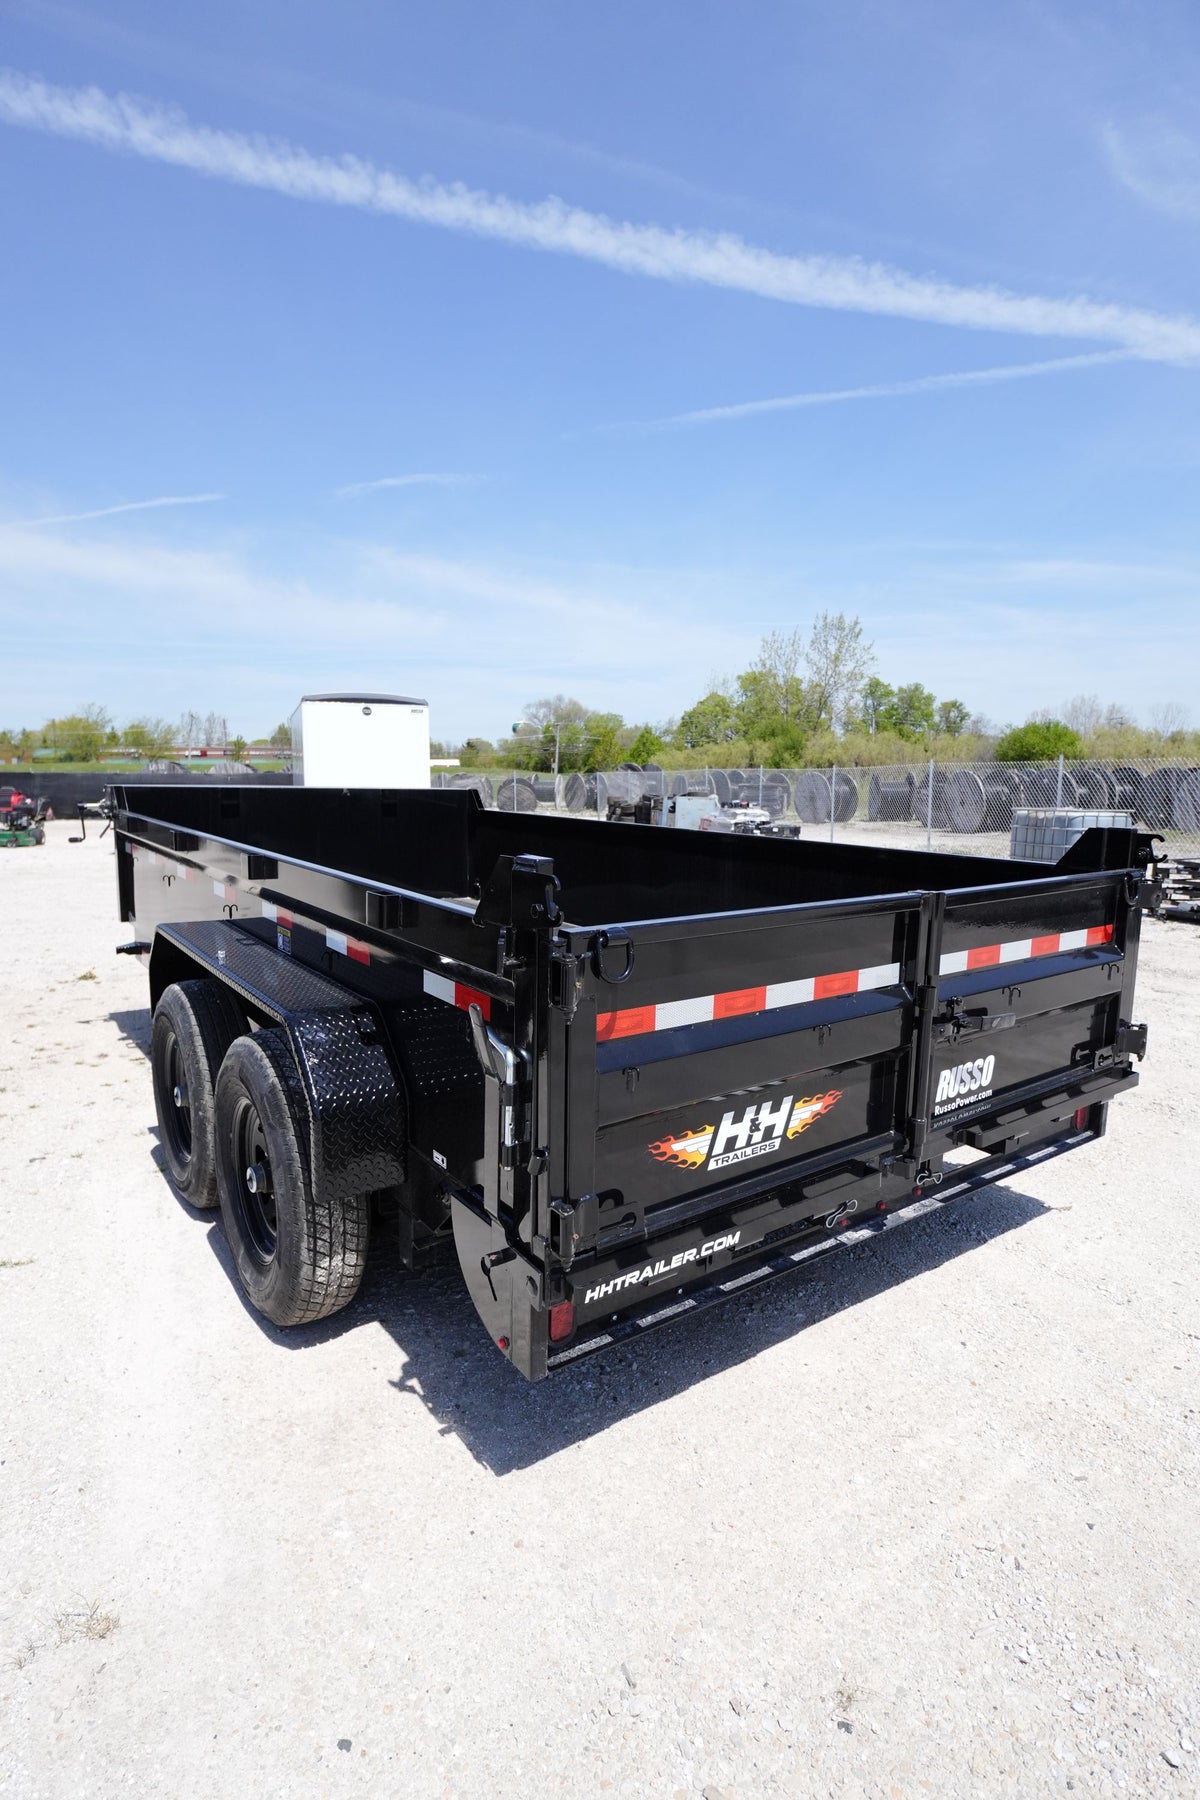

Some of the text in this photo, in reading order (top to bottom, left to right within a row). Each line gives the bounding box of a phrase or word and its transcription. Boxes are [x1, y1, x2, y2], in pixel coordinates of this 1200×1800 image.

[934, 1089, 993, 1117] RussoPower.com
[935, 1054, 996, 1103] RUSSO
[711, 1094, 794, 1156] H&H
[713, 1141, 776, 1167] TRAILERS
[584, 1230, 741, 1304] HHTRAILER.COM
